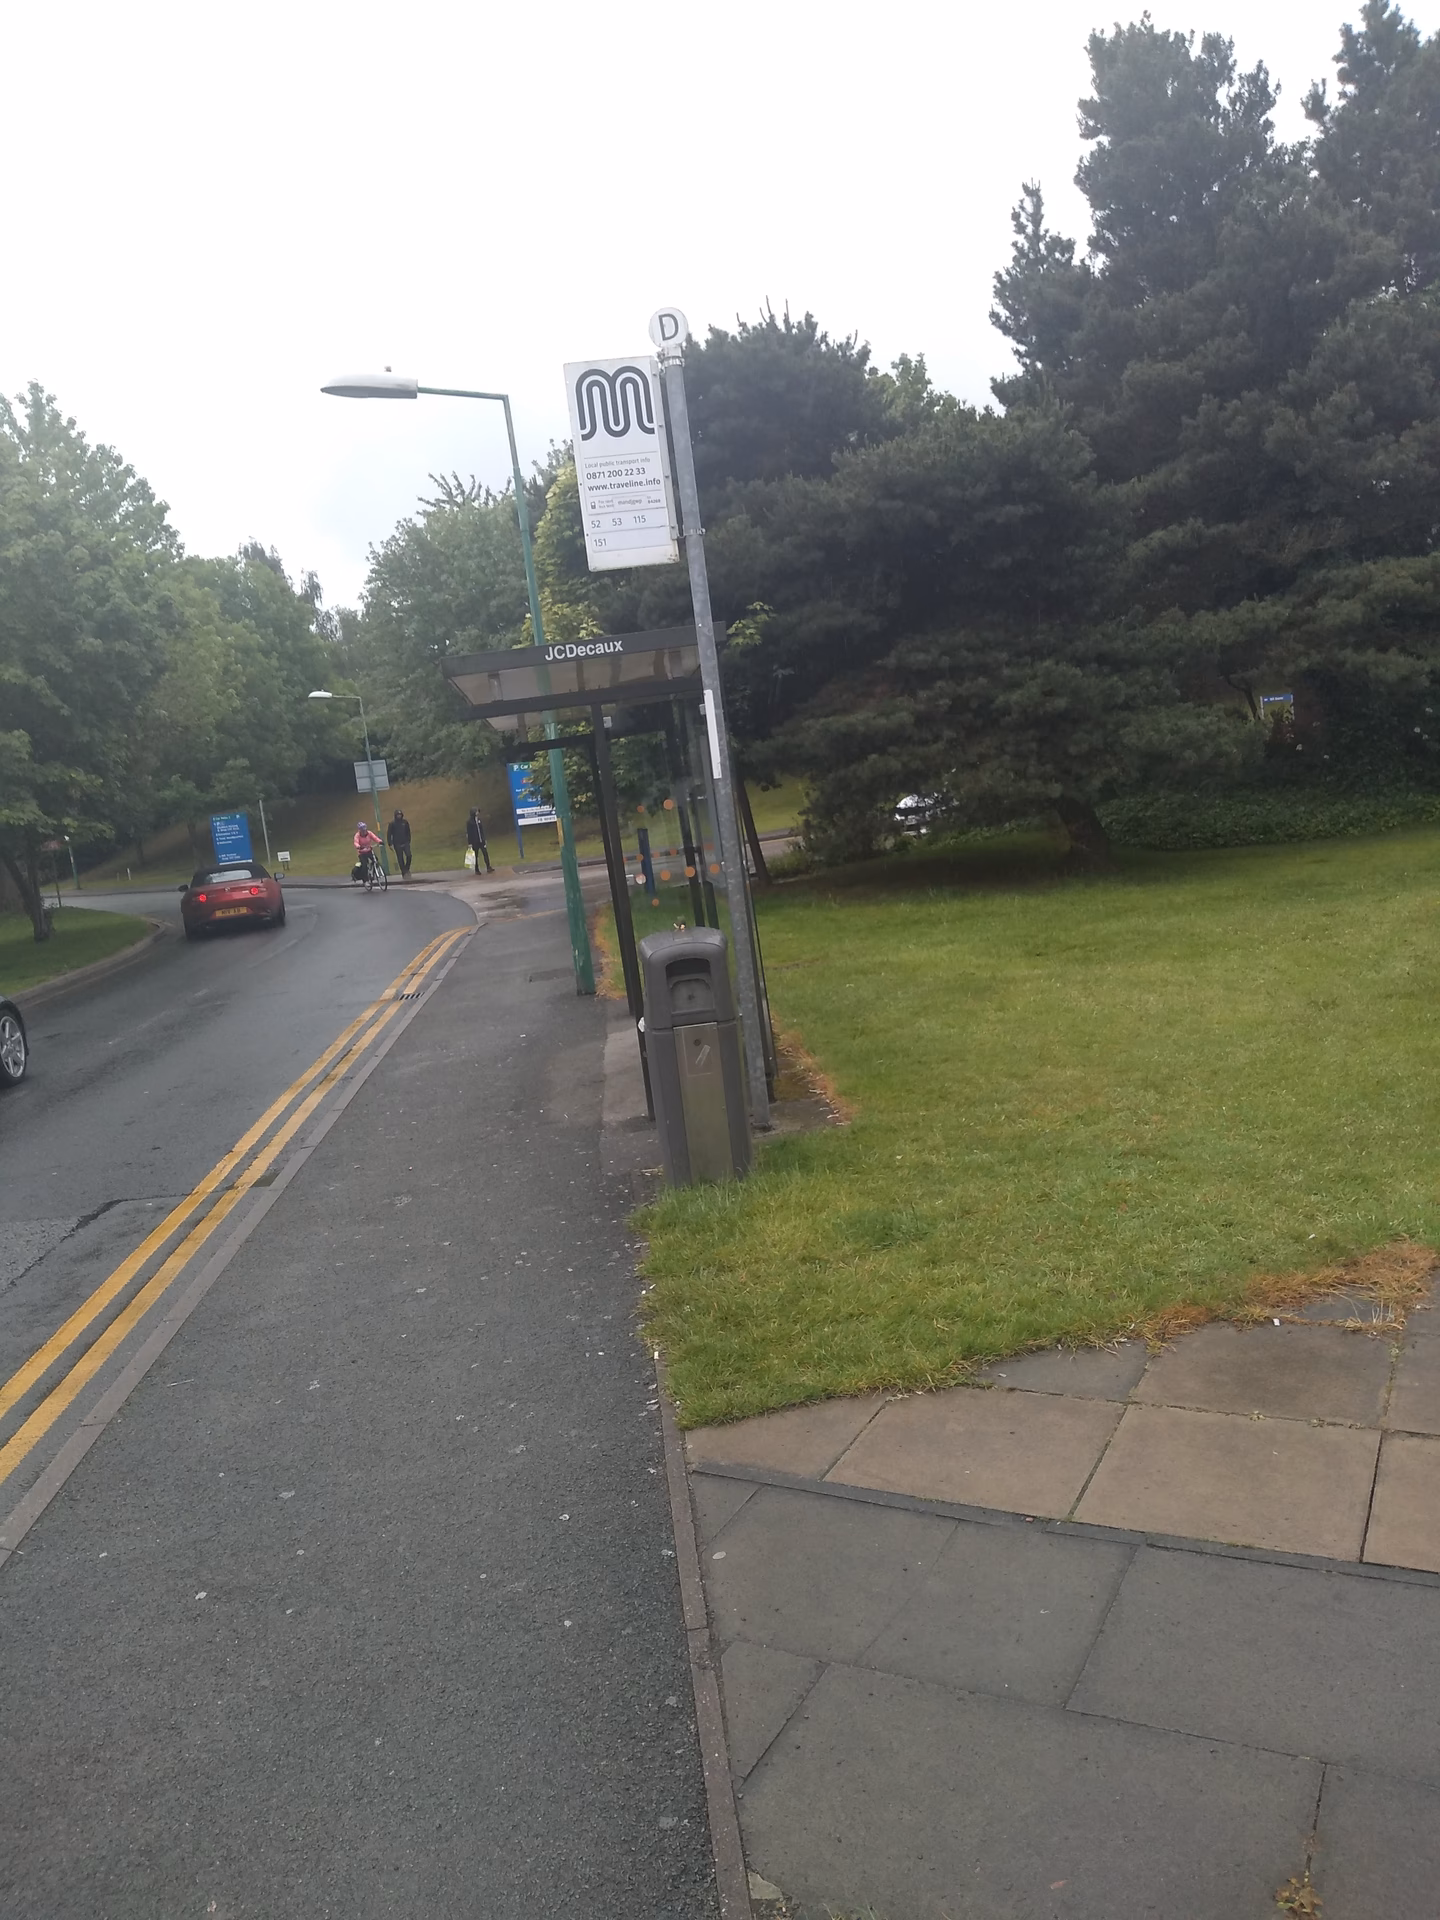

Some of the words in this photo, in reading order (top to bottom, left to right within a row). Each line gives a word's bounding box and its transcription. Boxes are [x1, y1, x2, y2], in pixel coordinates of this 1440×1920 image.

[658, 313, 679, 341] D
[585, 461, 598, 469] Local
[599, 460, 614, 468] public
[615, 458, 639, 466] transport
[586, 471, 606, 480] 0871
[607, 469, 623, 478] 200
[624, 468, 634, 477] 22
[635, 467, 646, 475] 33
[588, 478, 661, 491] www.traveline.info
[591, 520, 601, 529] 52
[612, 518, 622, 526] 53
[633, 515, 647, 524] 115
[593, 538, 607, 547] 151
[545, 640, 624, 661] JCDecaux
